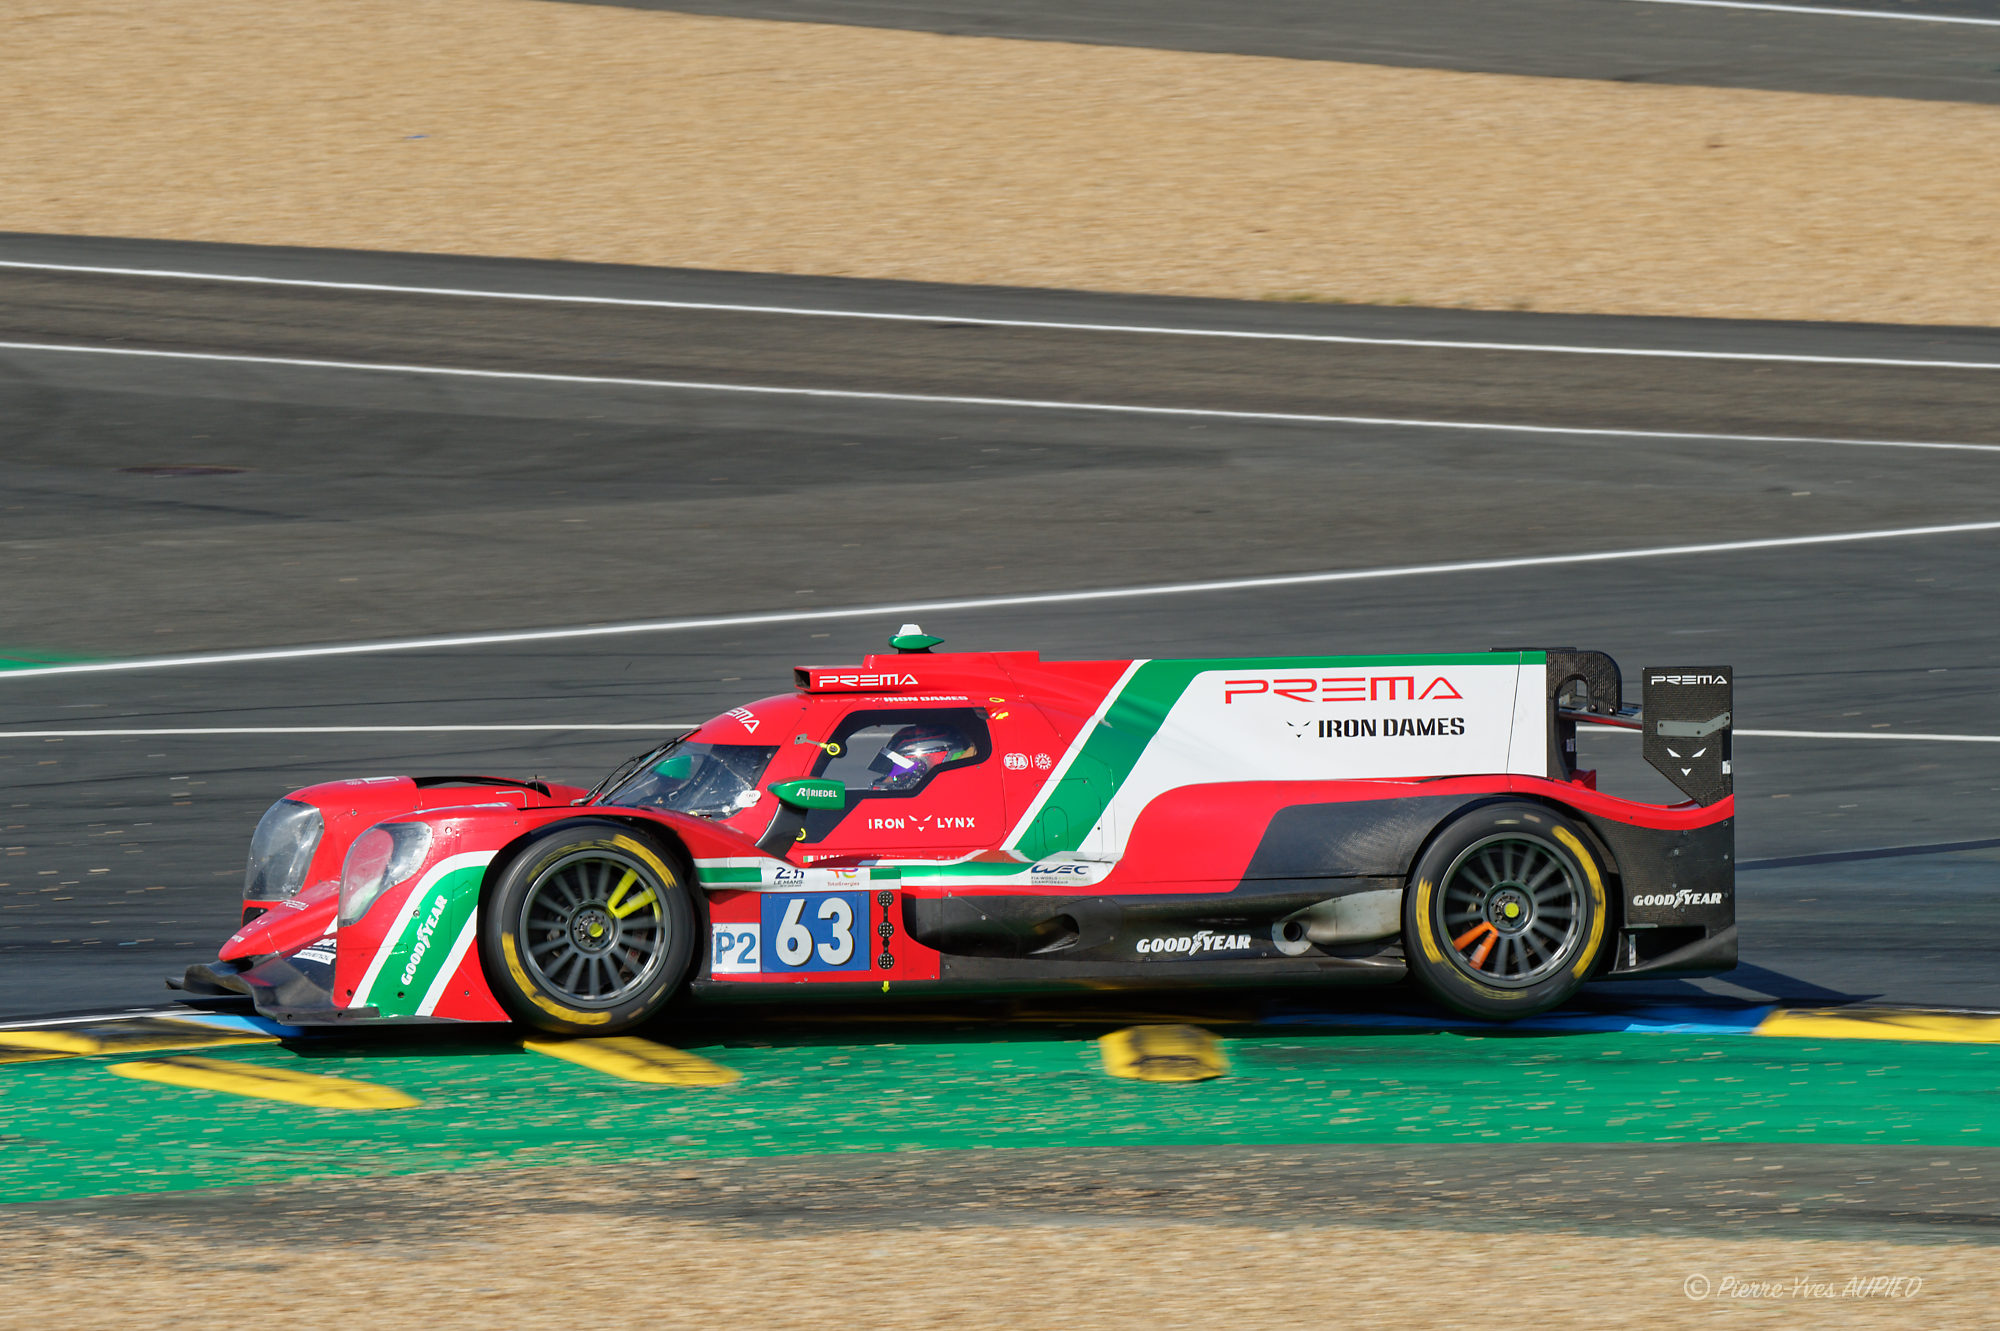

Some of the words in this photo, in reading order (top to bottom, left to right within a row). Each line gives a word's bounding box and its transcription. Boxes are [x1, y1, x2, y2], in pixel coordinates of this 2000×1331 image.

[819, 673, 918, 688] PREMA
[1651, 675, 1727, 686] PREMA
[883, 695, 918, 703] IRON
[1225, 676, 1464, 704] PREMA
[1318, 719, 1376, 738] IRON
[1383, 717, 1465, 737] DAMES
[1004, 754, 1027, 770] FIA
[810, 789, 838, 798] RIEDEL
[868, 818, 905, 830] IRON
[937, 817, 975, 829] LYNX
[1031, 864, 1089, 875] WEC
[1633, 889, 1722, 909] GOODYEAR
[401, 895, 448, 985] GOODYEAR
[775, 897, 854, 966] 63
[716, 932, 757, 965] P2
[1136, 930, 1251, 956] GOODYEAR
